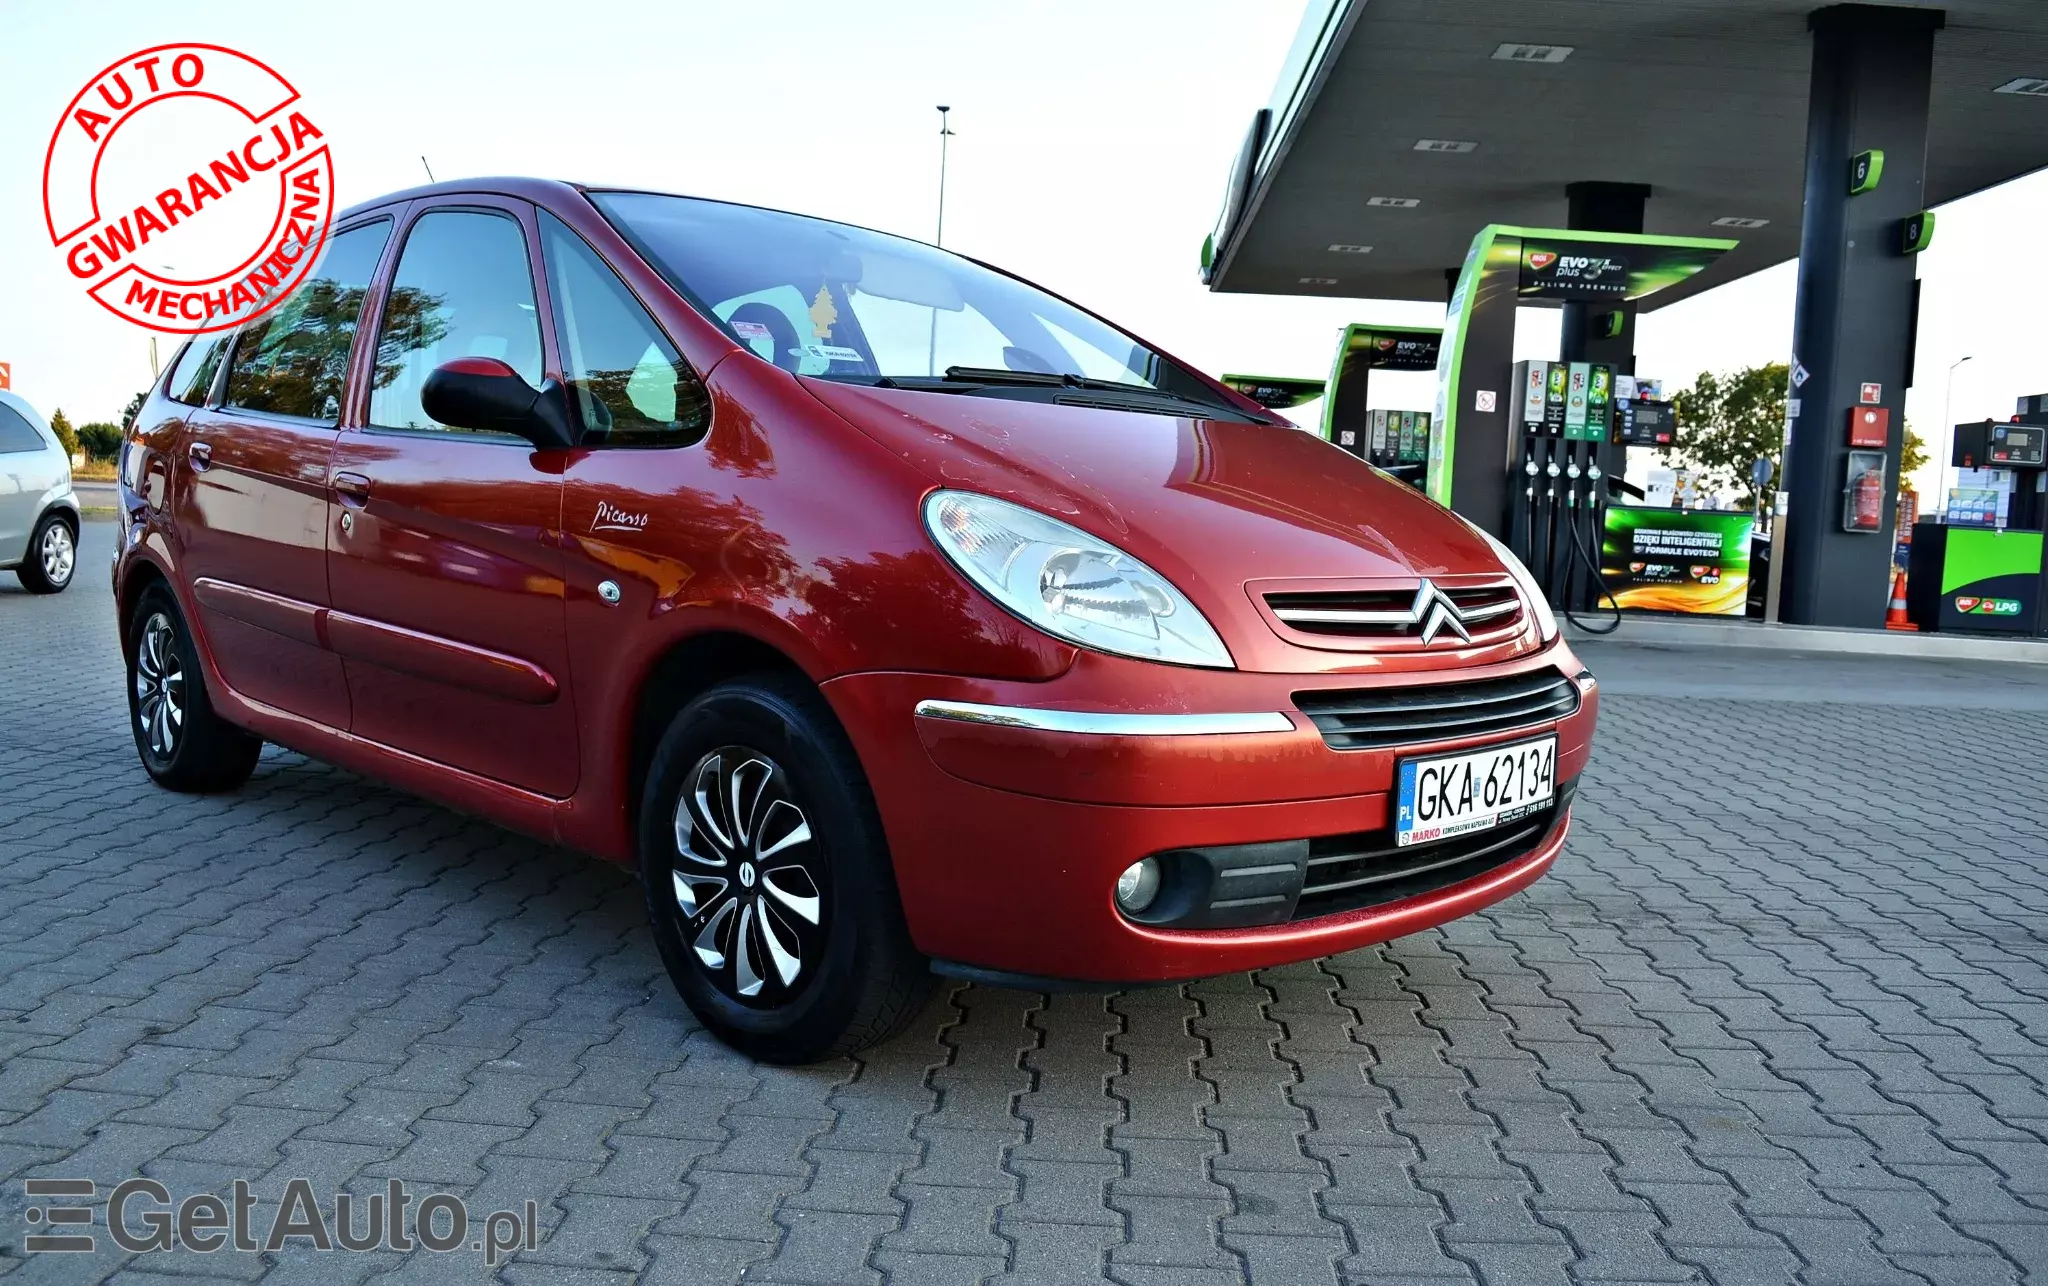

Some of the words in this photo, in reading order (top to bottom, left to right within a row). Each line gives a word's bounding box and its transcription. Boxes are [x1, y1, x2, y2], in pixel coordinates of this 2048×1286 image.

[1857, 162, 1865, 179] 6
[1909, 223, 1917, 240] 8
[1559, 256, 1588, 268] EVO
[1556, 267, 1580, 277] plus
[1397, 341, 1416, 350] EVO
[589, 501, 648, 533] Picasso
[1633, 535, 1660, 546] DZIĘKI
[1661, 536, 1722, 548] INTELIGENTNEJ
[1645, 546, 1682, 555] FORMULE
[1683, 548, 1719, 557] EVOTECH
[1701, 576, 1719, 584] EVO
[1995, 602, 2018, 612] LPG
[1418, 761, 1473, 822] GKA
[1484, 744, 1553, 808] 62134
[1400, 805, 1412, 821] PL
[1412, 827, 1441, 843] MARKO
